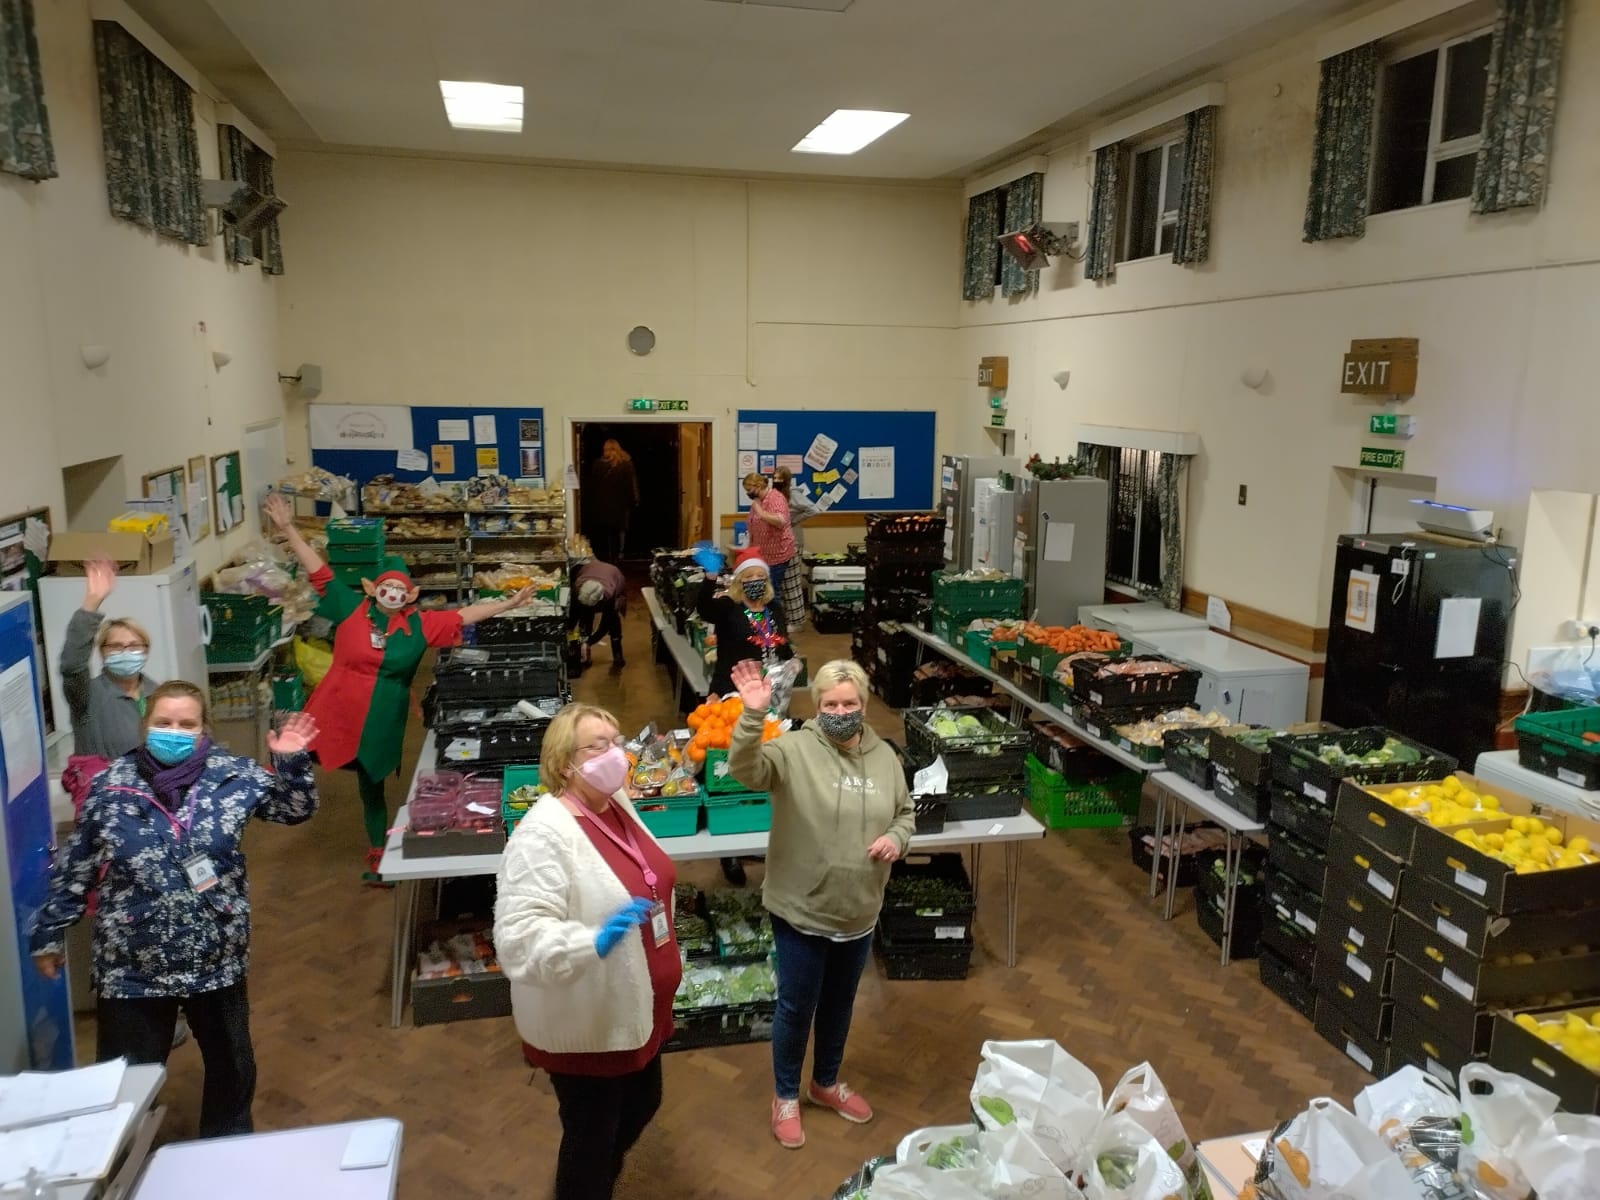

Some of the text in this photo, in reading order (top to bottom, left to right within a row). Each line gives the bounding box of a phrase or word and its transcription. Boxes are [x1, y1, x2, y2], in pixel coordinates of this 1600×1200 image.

[979, 368, 993, 383] EXIT
[1344, 361, 1391, 385] EXIT
[1360, 450, 1393, 464] FIRE EXIT
